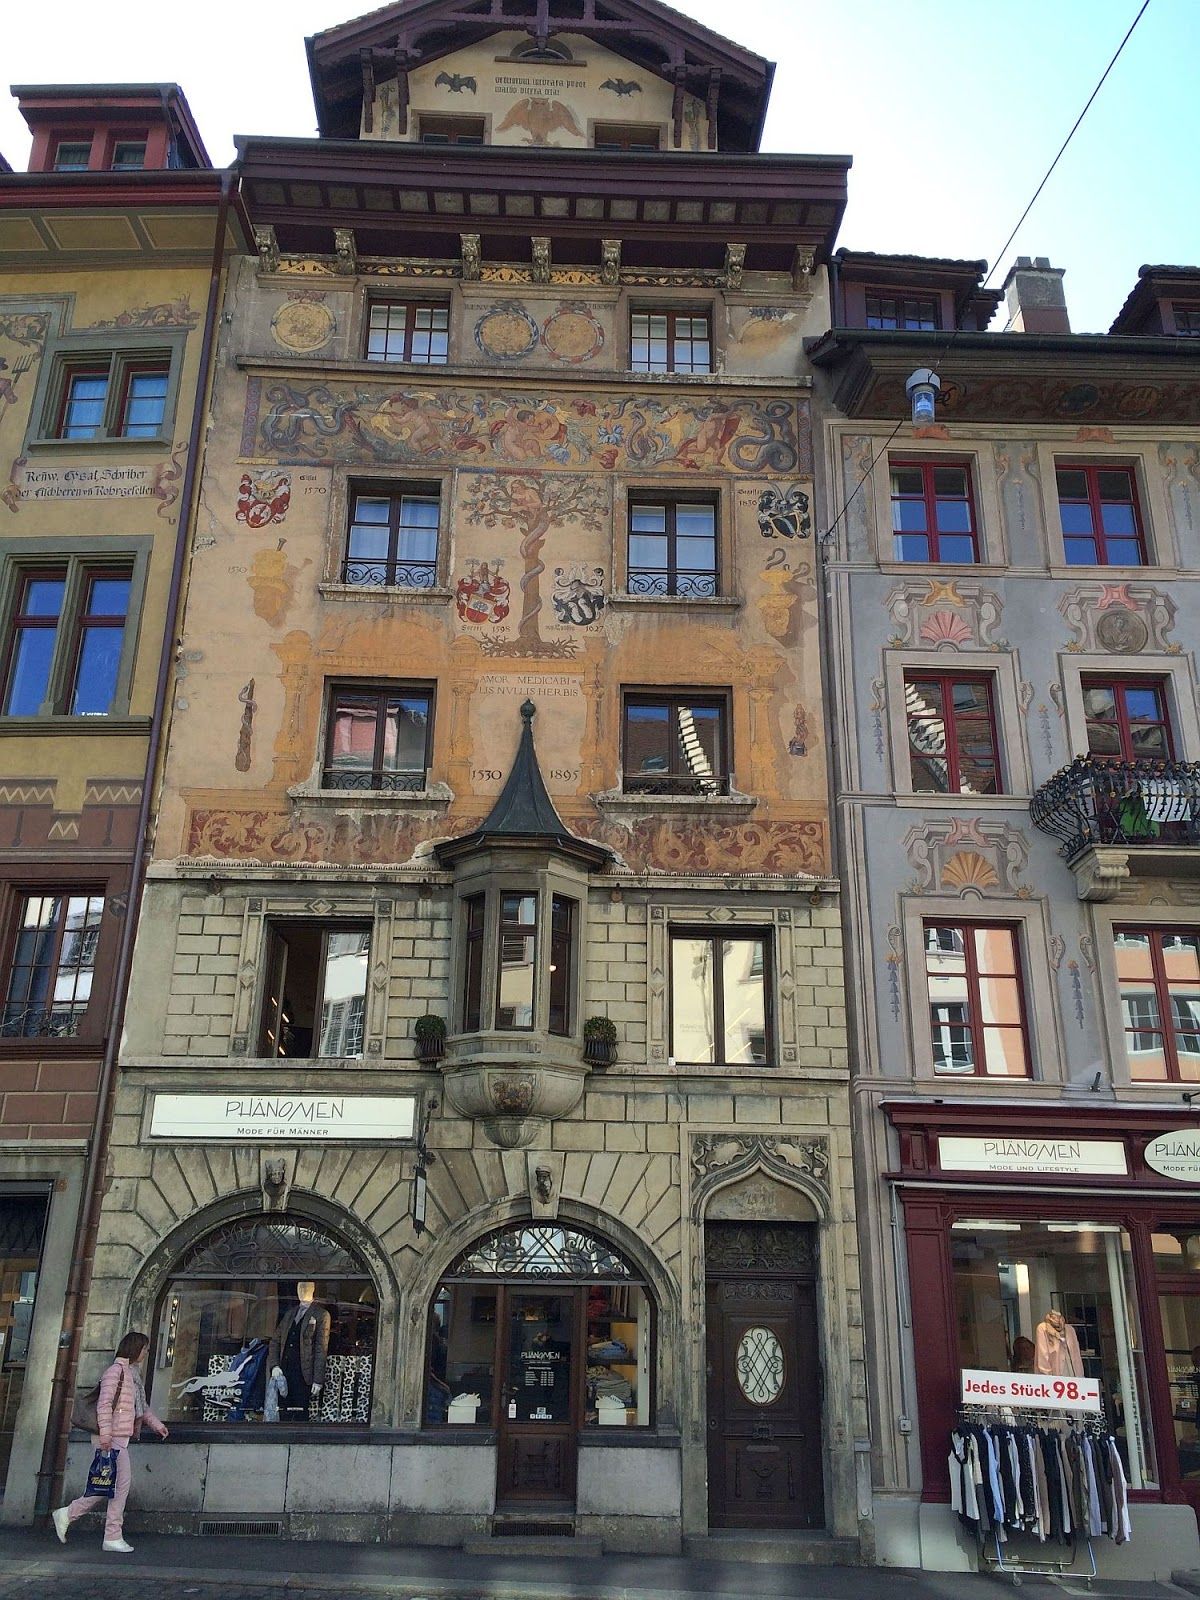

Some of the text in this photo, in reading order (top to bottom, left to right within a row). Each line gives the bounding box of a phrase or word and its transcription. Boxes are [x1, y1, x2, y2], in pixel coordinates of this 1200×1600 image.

[480, 675, 509, 684] AMOR
[480, 687, 495, 695] LIS
[472, 769, 503, 782] 1530
[550, 769, 581, 782] 1895
[225, 1097, 345, 1122] PHÄNOMEN
[984, 1139, 1081, 1161] PHÄNOMEN
[965, 1379, 1007, 1395] Jedes
[1011, 1382, 1051, 1398] Stück
